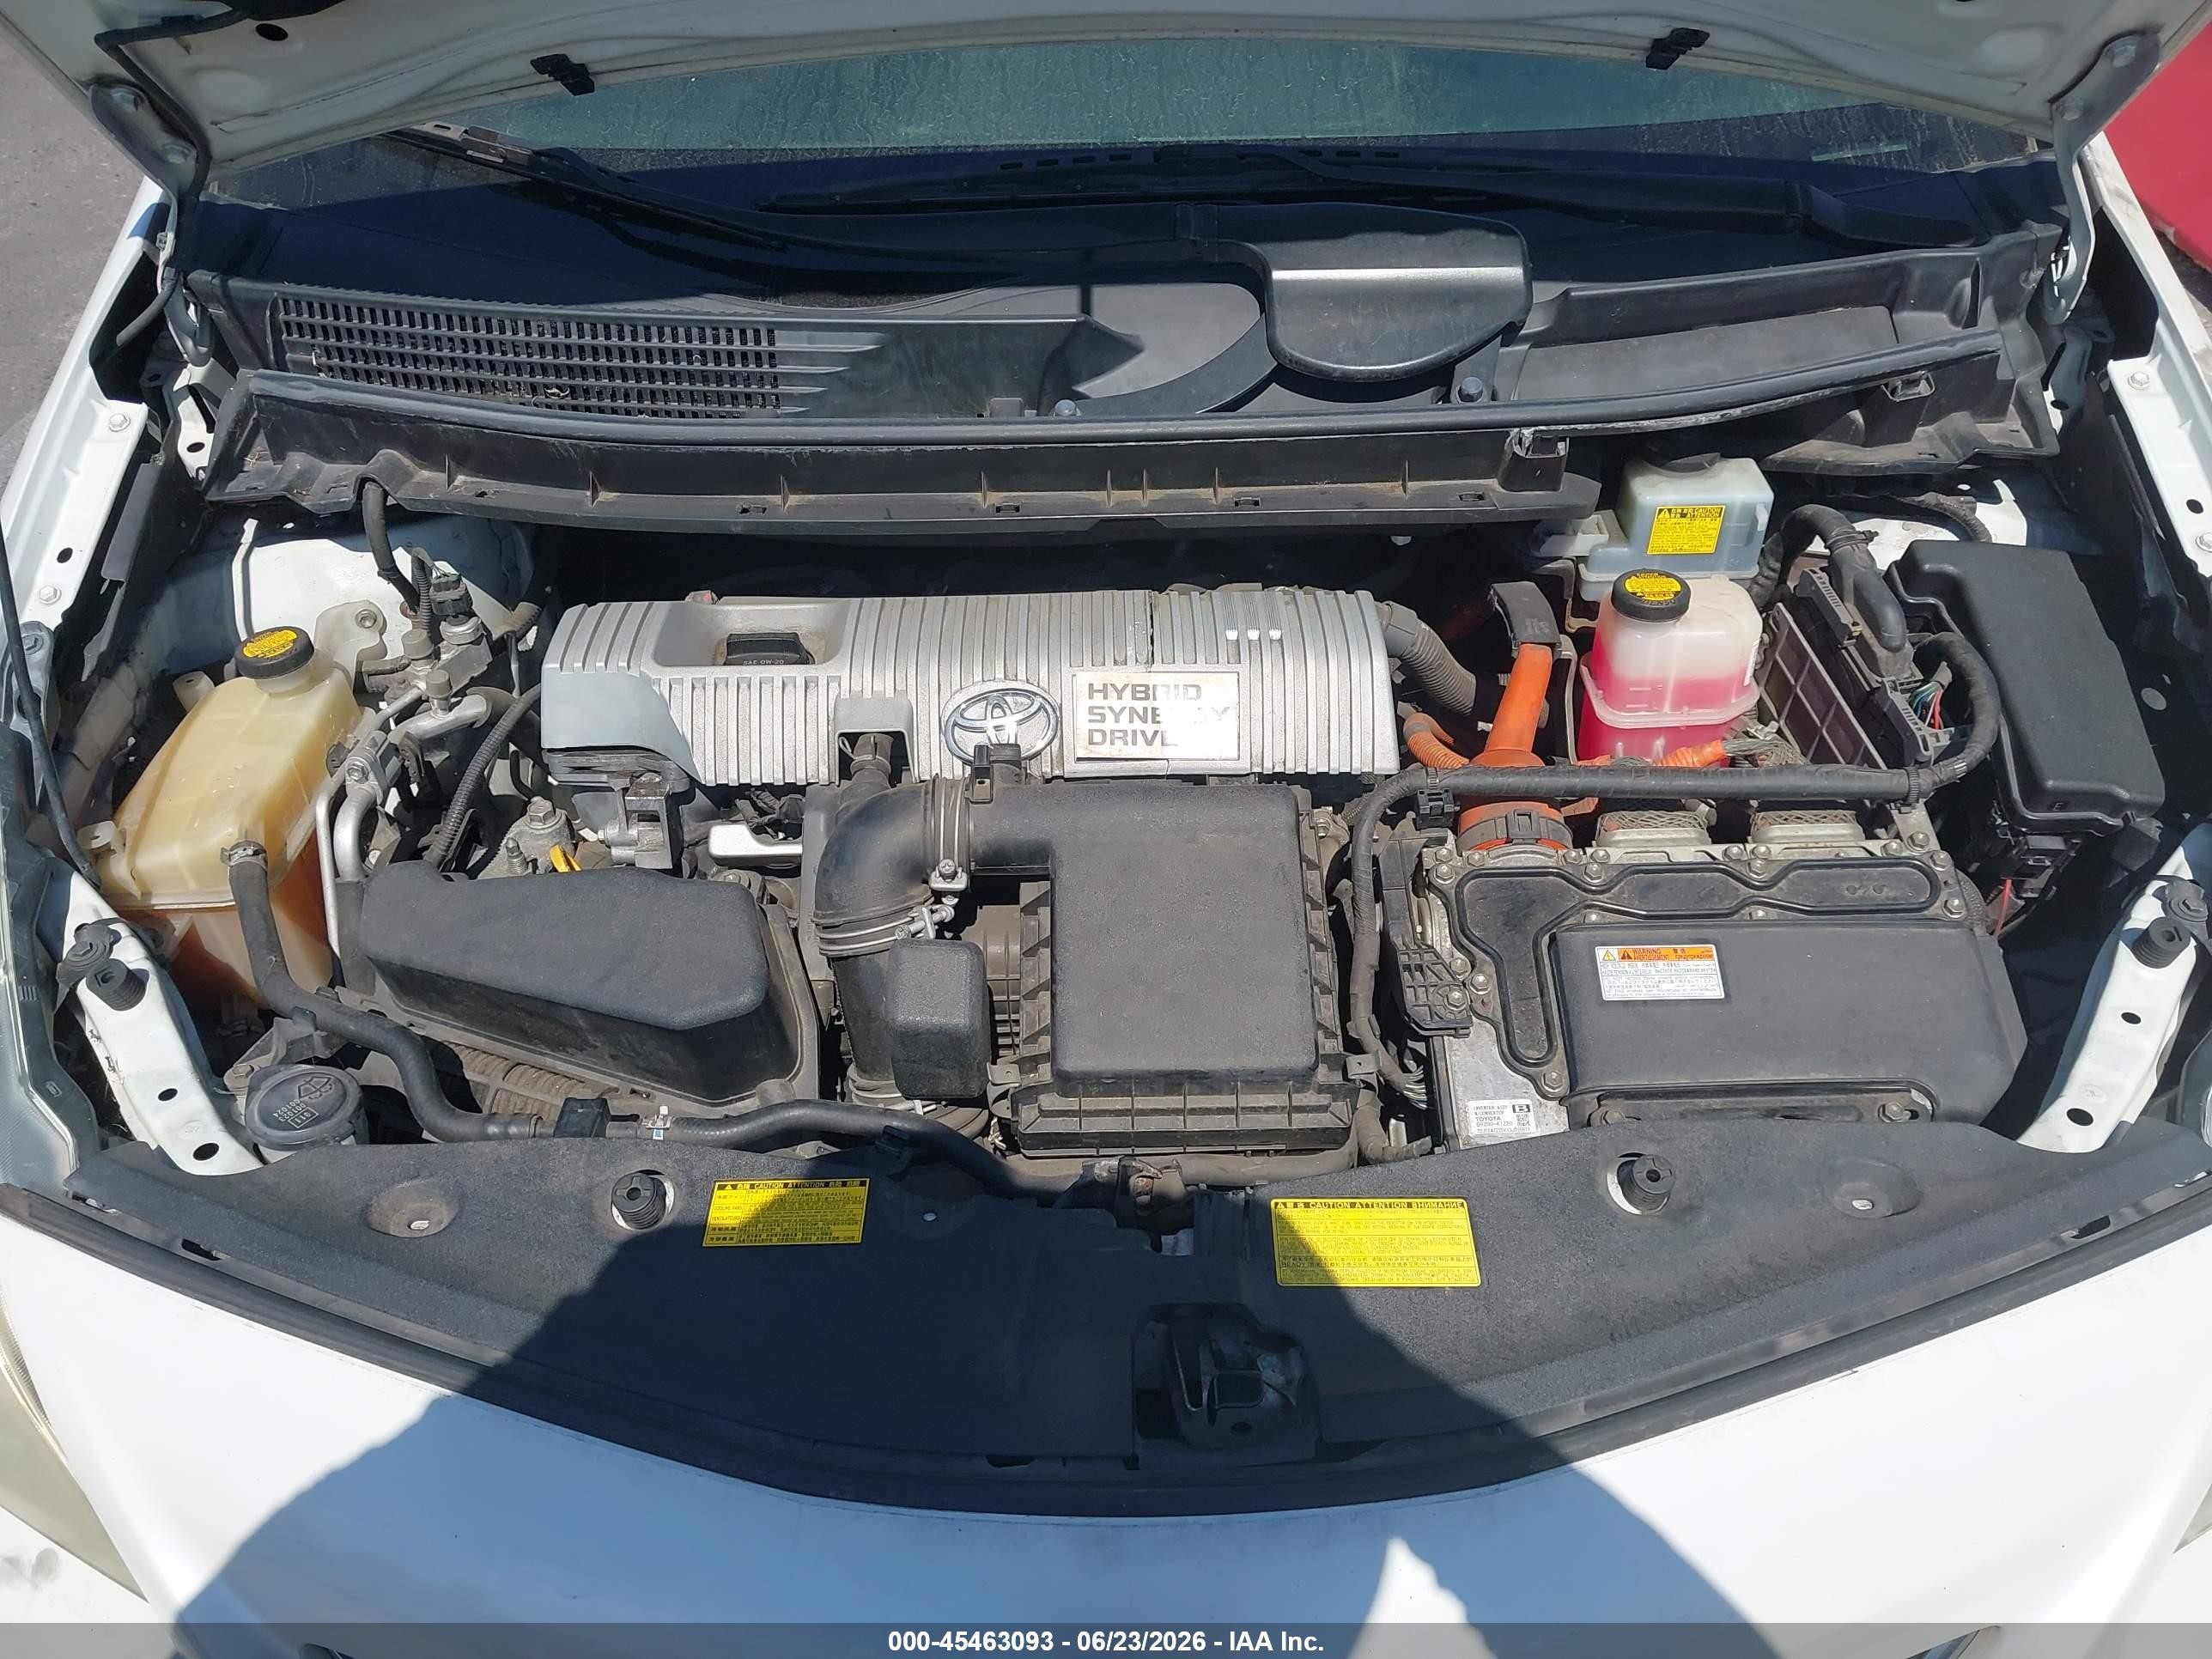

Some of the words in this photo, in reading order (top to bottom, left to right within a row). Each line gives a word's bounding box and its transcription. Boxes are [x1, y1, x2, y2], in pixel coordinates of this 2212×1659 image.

[1088, 683, 1202, 701] HYBRID
[1088, 706, 1231, 724] SYNEY
[1515, 1104, 1529, 1113] B
